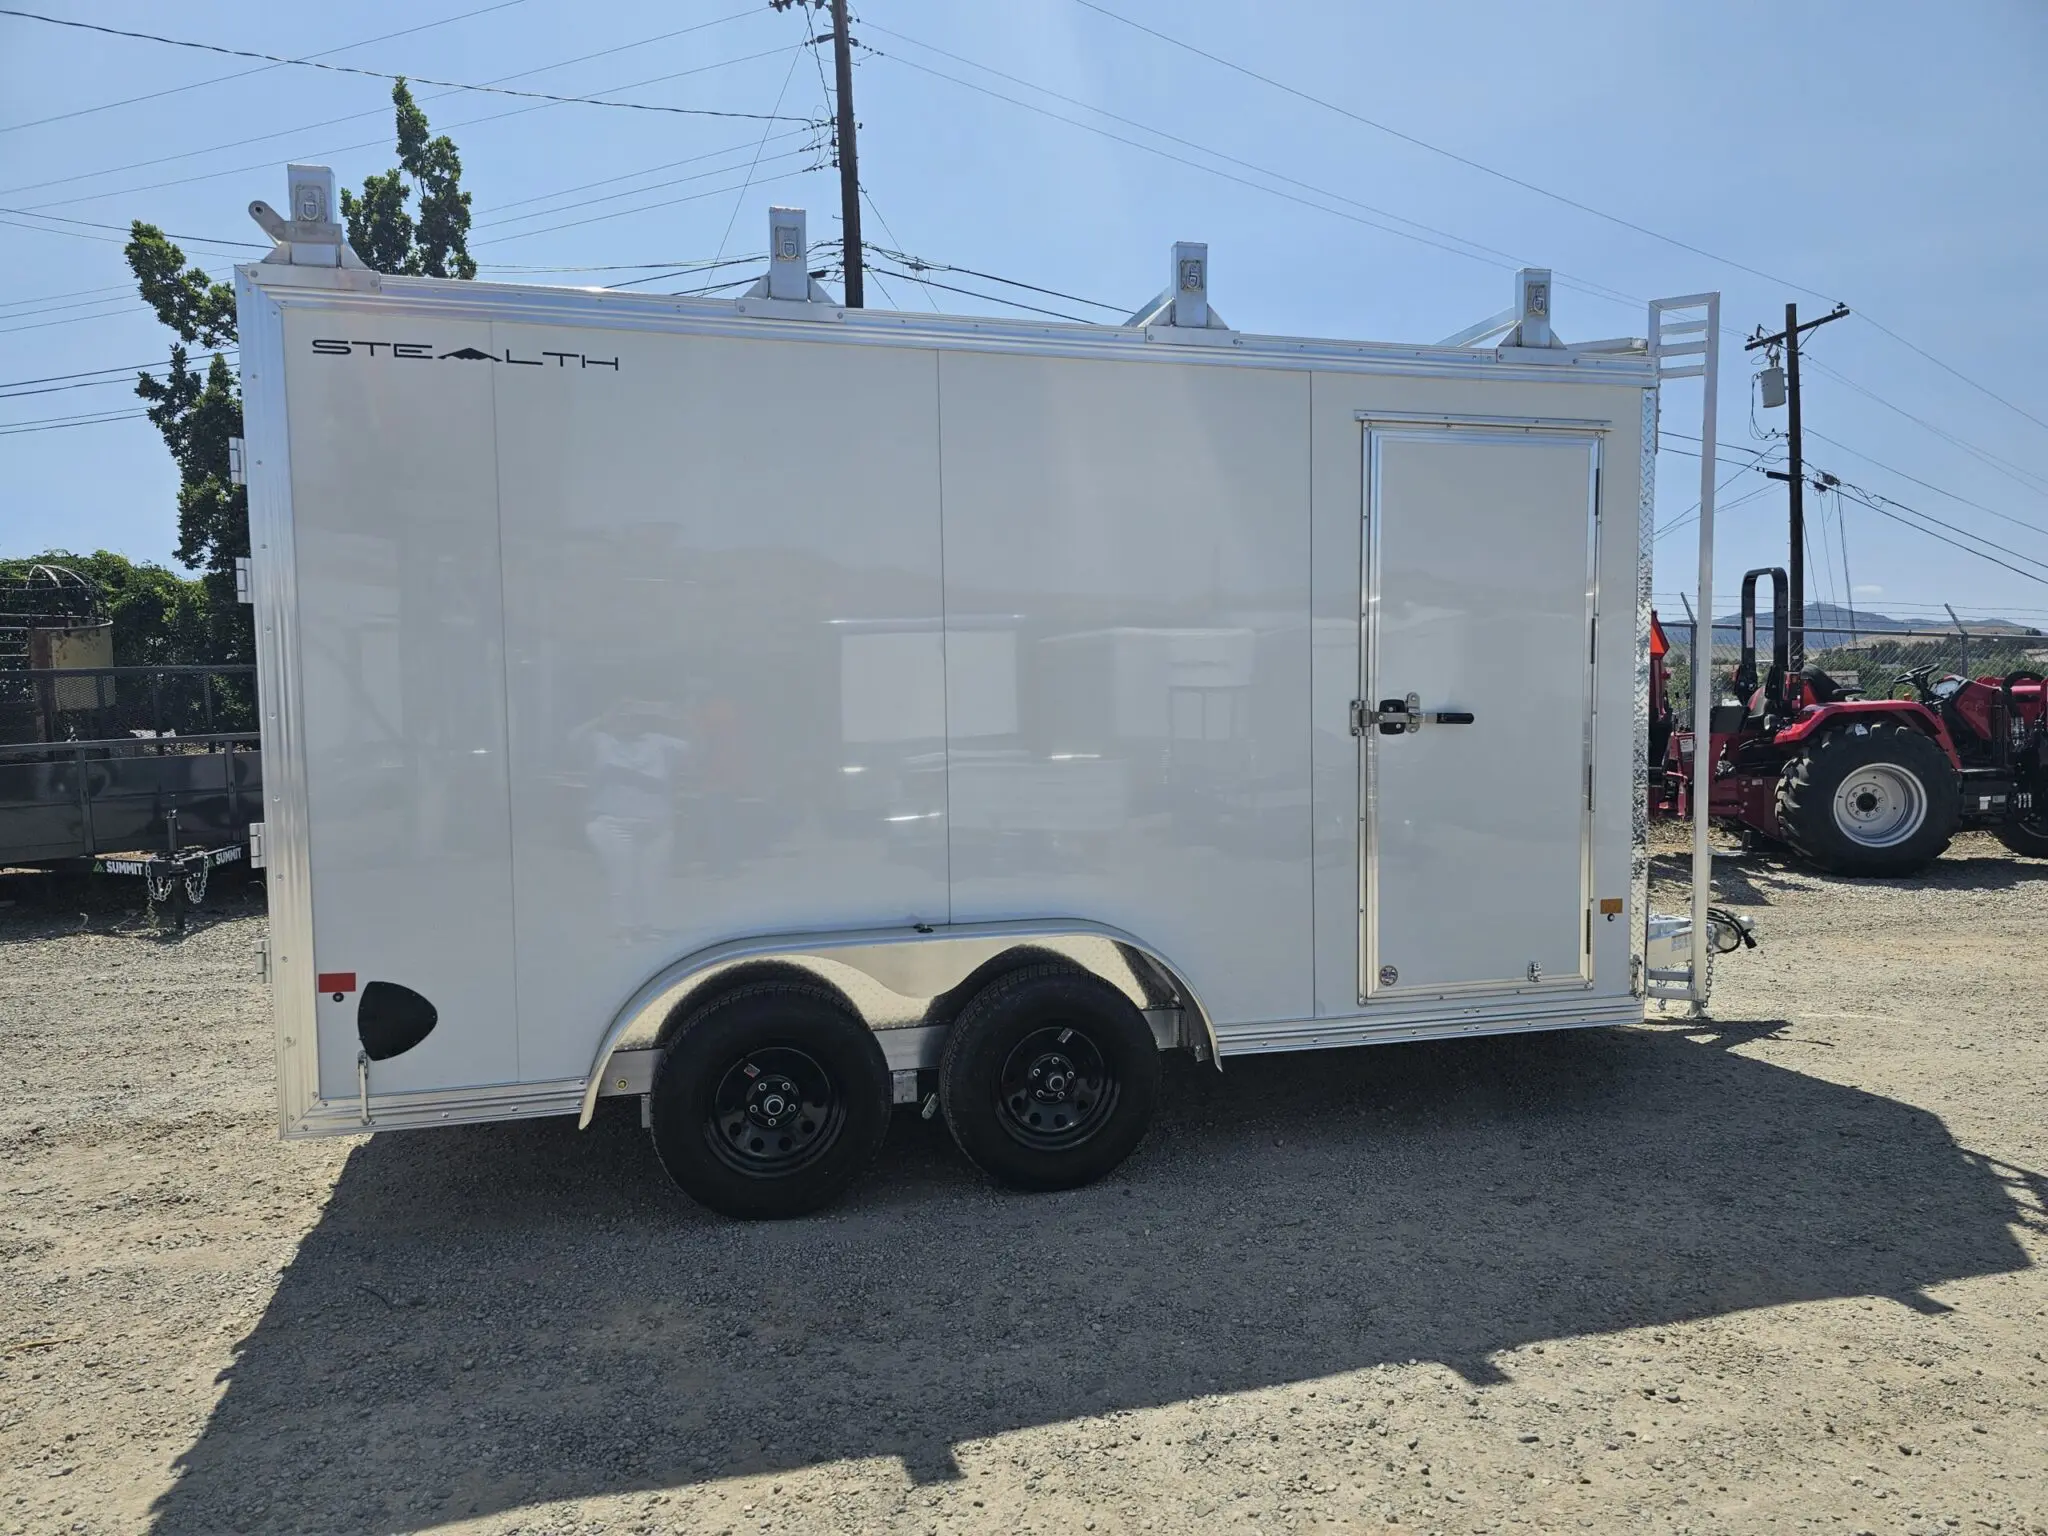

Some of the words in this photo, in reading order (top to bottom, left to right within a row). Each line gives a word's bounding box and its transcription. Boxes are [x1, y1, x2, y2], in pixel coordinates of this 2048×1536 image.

[311, 339, 619, 371] STEALTH
[215, 847, 242, 865] SUMMIT
[106, 861, 144, 876] SUMMIT
